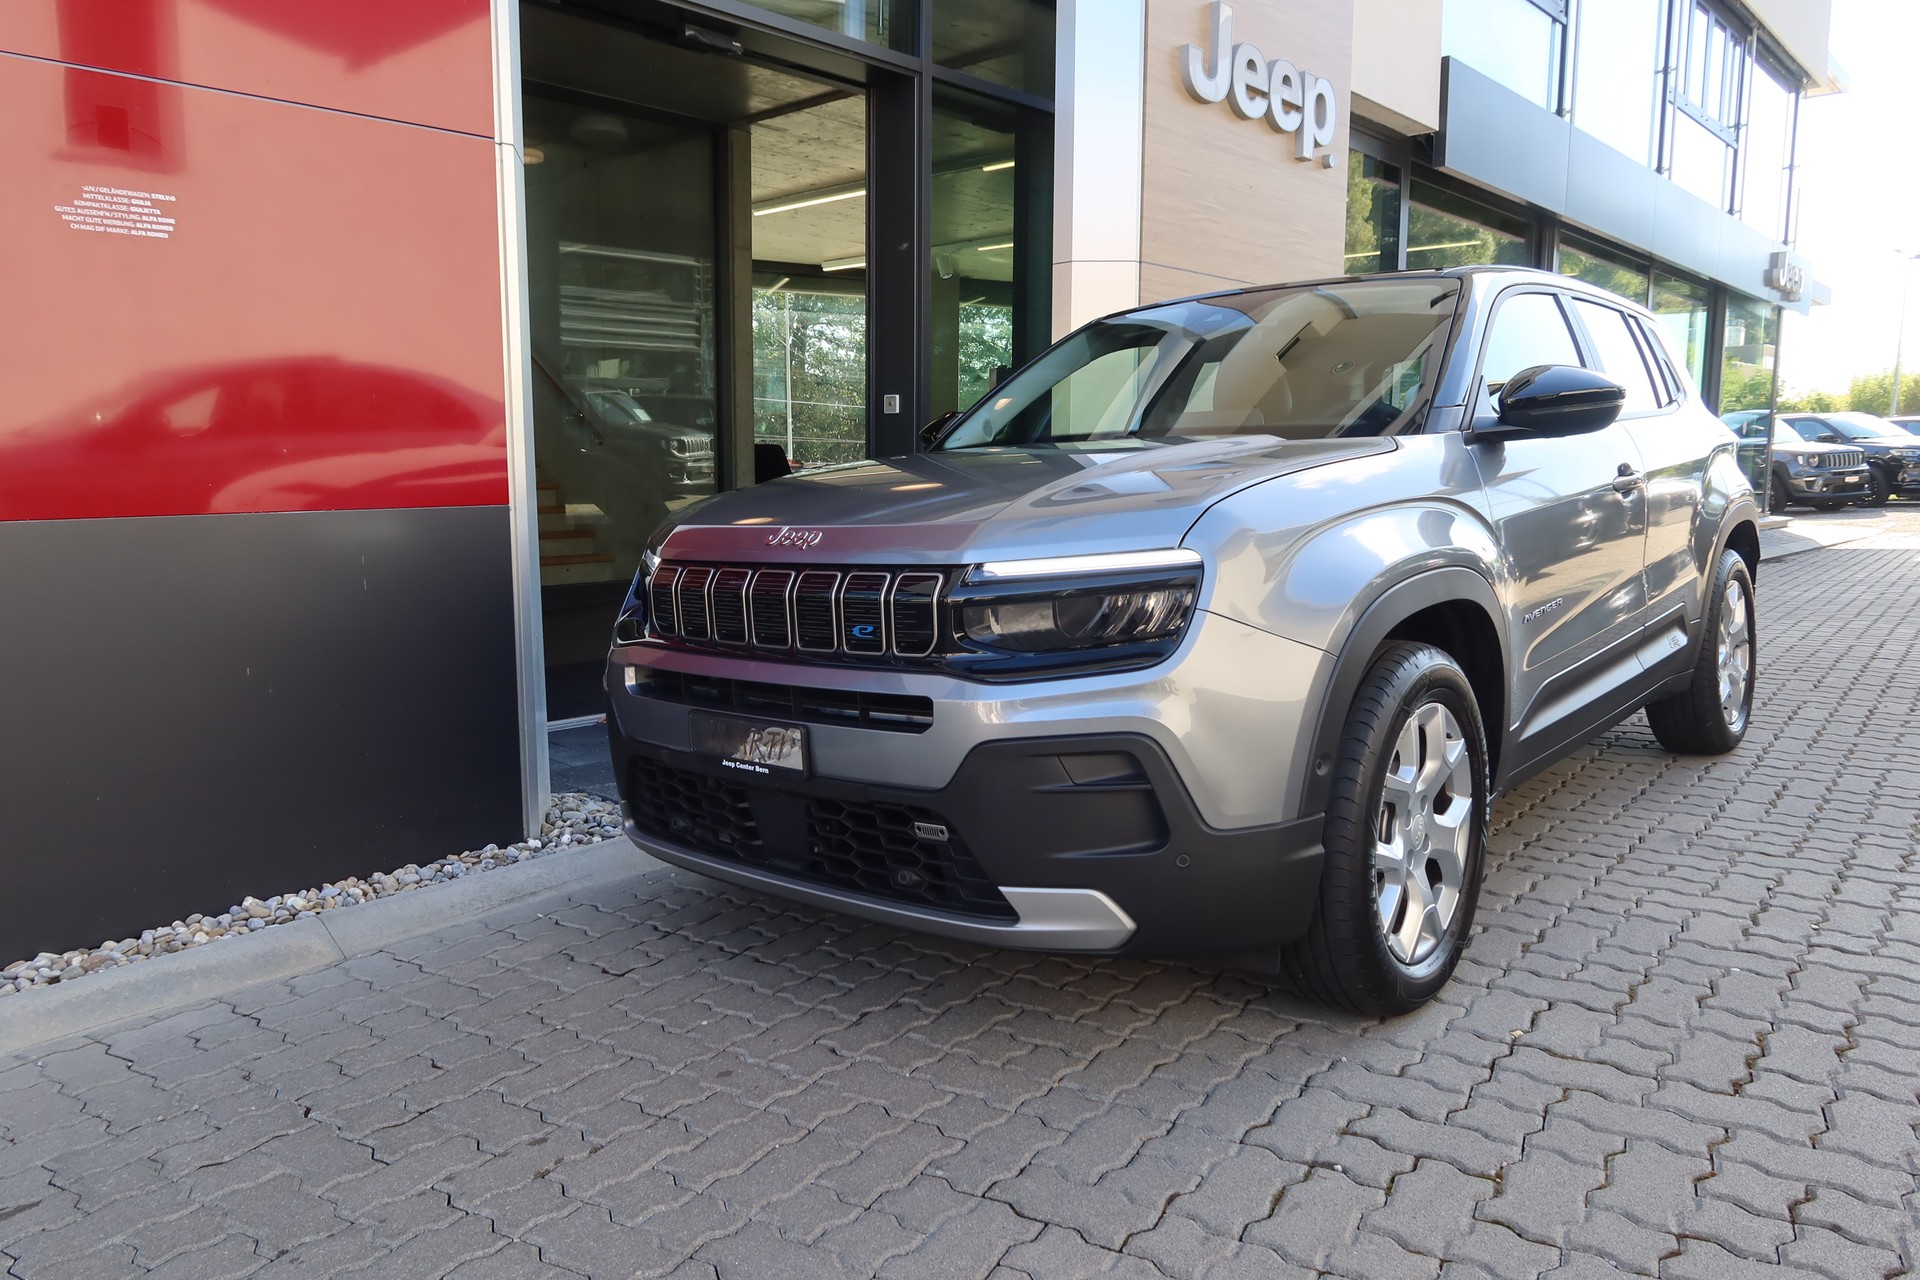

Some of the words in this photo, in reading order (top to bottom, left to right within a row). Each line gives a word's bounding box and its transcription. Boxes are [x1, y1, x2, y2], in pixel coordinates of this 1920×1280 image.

[1180, 0, 1336, 162] Jeep
[54, 205, 76, 213] GUTES
[61, 214, 84, 222] MACHT
[151, 224, 174, 232] ROMEO
[147, 231, 169, 239] ROMEO
[1770, 251, 1804, 302] Jeep
[765, 526, 823, 550] Jeep
[1522, 597, 1563, 624] AVENGER
[721, 758, 735, 769] Jeep
[736, 761, 755, 771] Center
[755, 765, 769, 774] Bern
